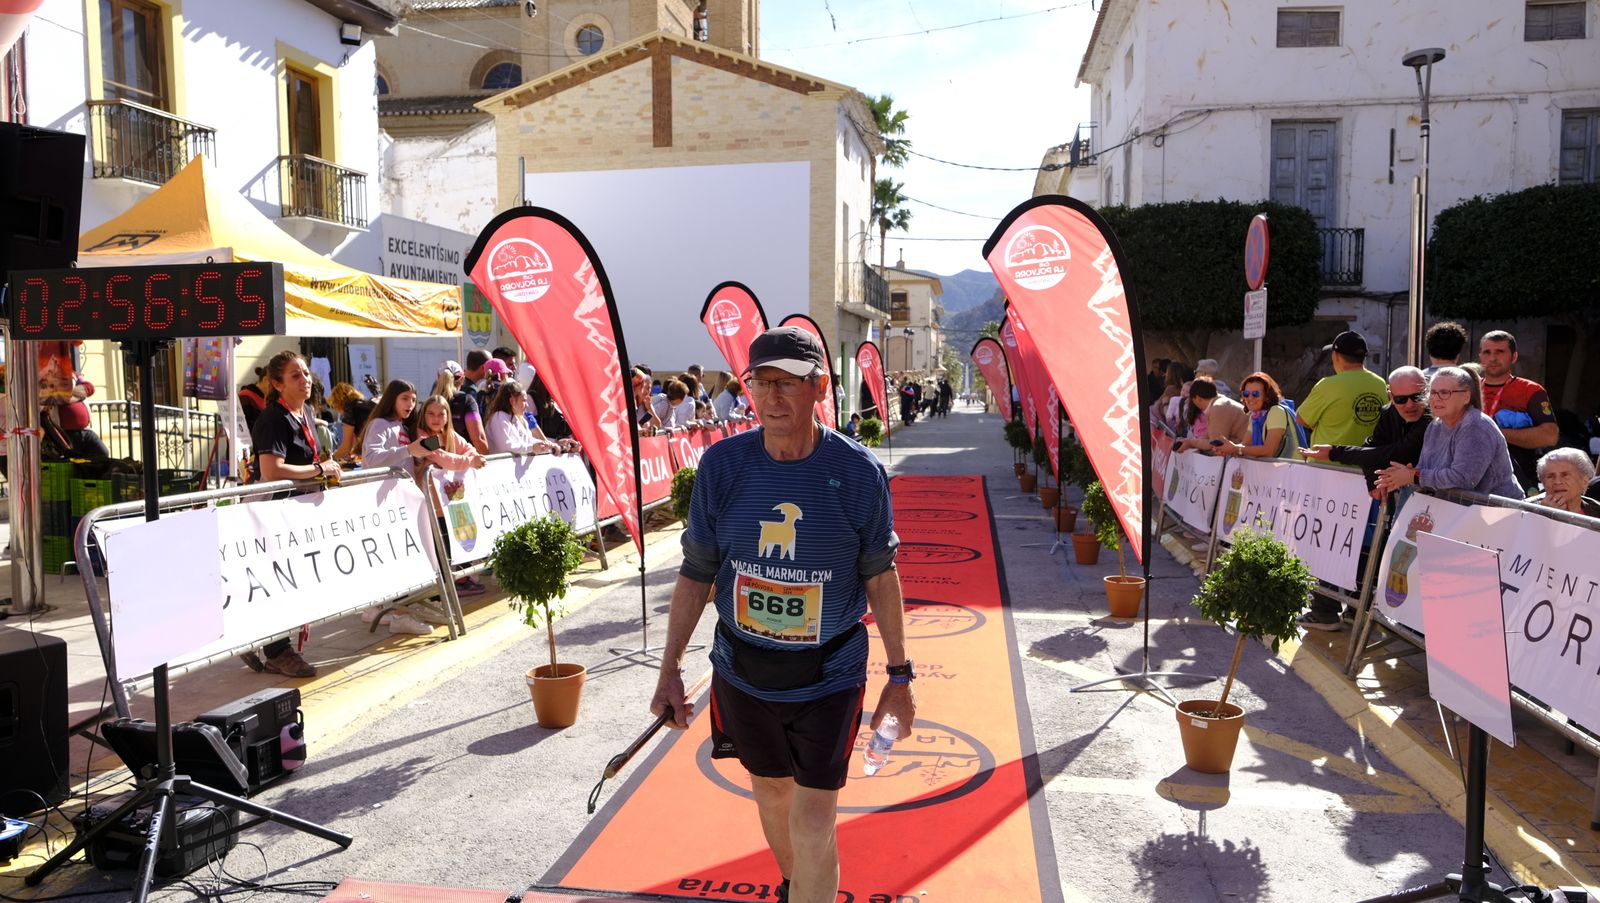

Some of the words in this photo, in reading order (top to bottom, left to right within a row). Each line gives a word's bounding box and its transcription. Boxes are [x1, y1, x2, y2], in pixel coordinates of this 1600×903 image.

[388, 237, 459, 265] EXCELENTÍSIMO
[390, 262, 458, 286] AYUNTAMIENTO
[19, 269, 266, 334] 02:56:55
[640, 456, 669, 485] OLIA
[481, 486, 589, 530] CANTORIA
[1341, 502, 1359, 520] DE
[219, 514, 382, 562] YUNTAMIENTO
[387, 506, 408, 524] DE
[731, 559, 764, 577] MACAEL
[766, 565, 809, 582] MARMOL
[811, 569, 833, 584] CXM
[748, 591, 804, 617] 668
